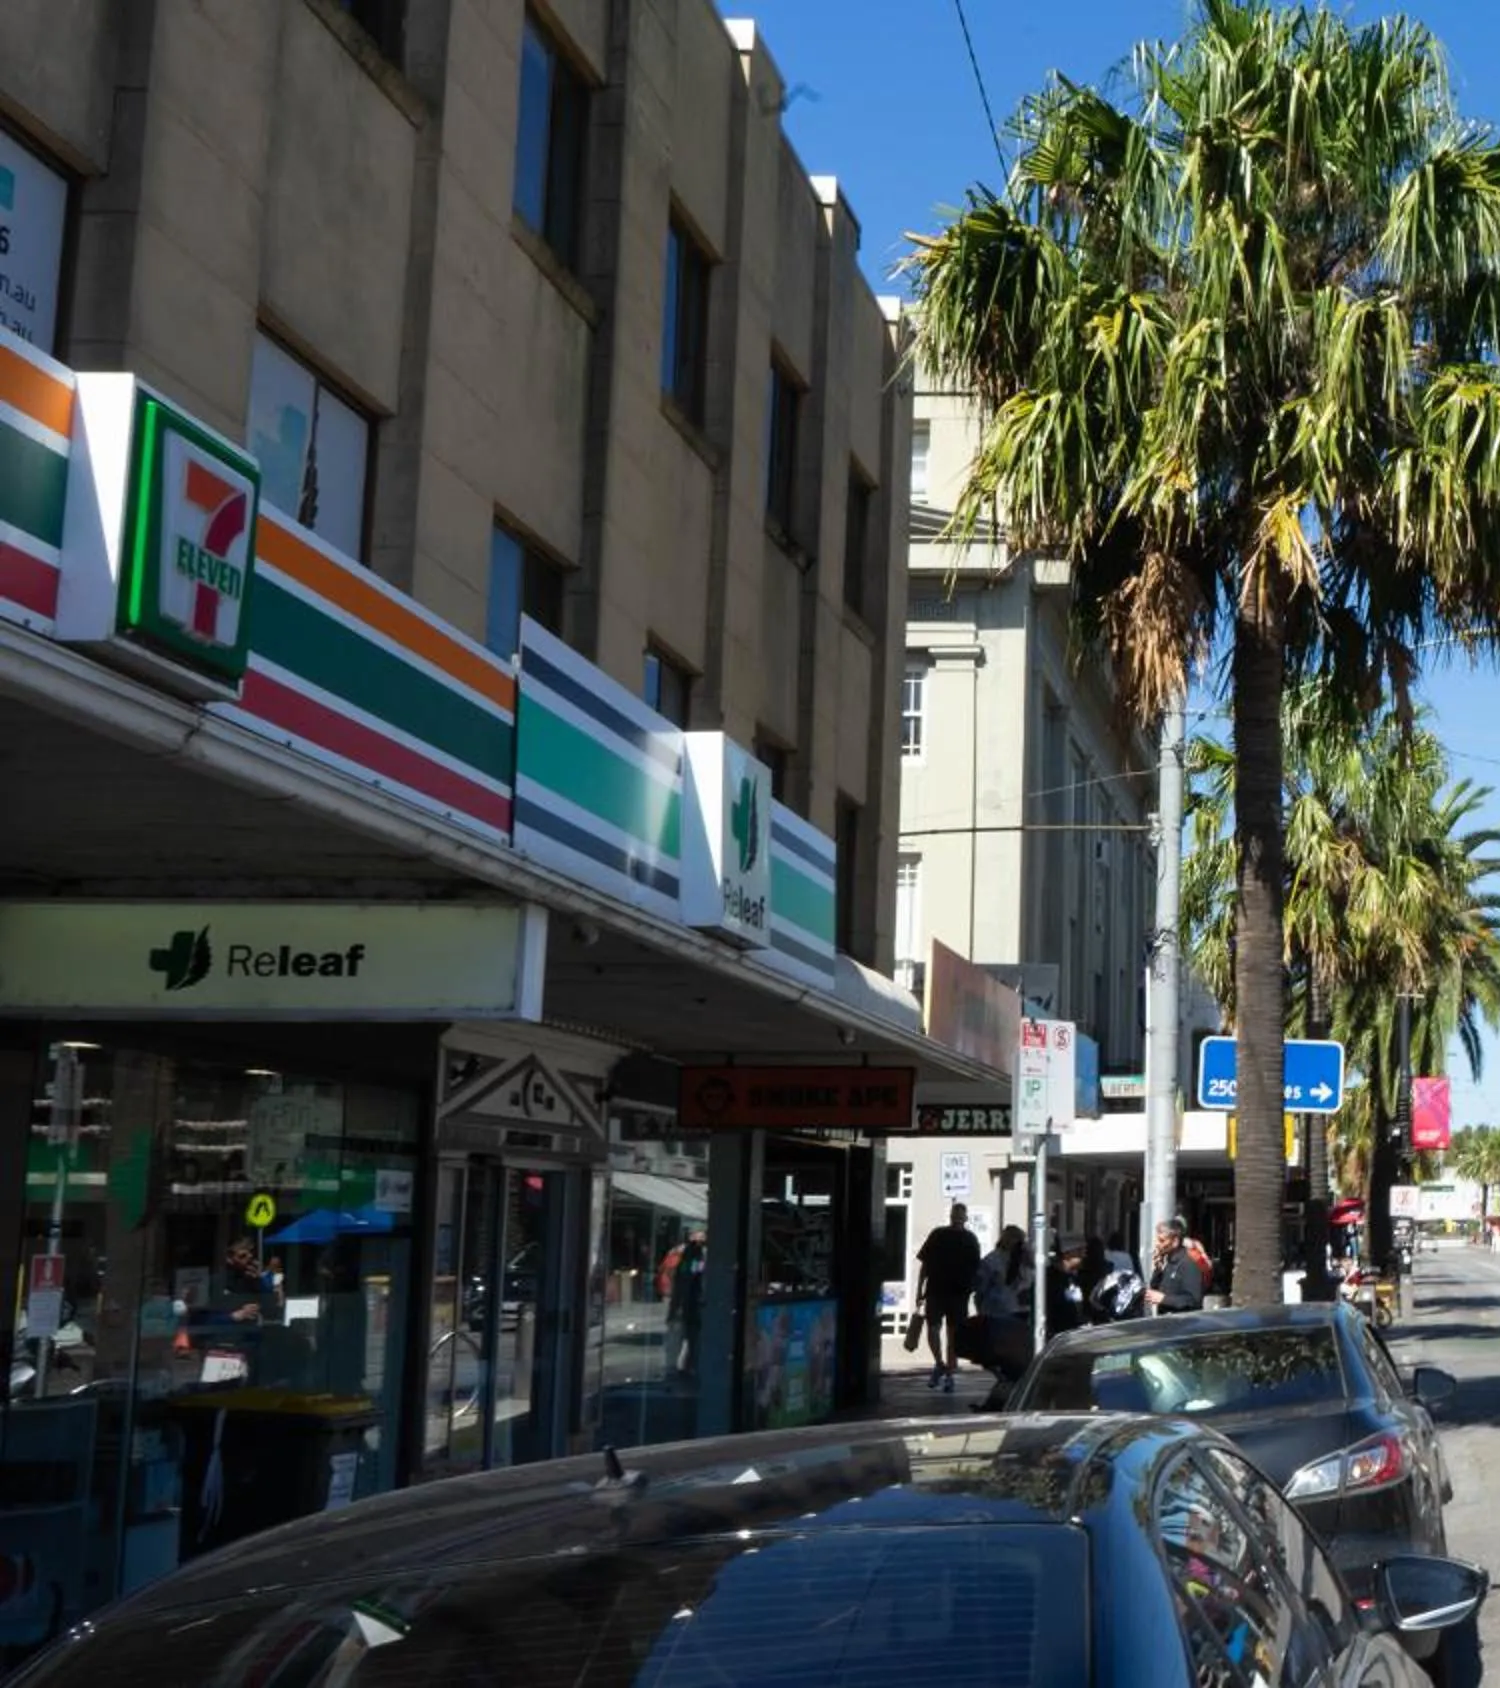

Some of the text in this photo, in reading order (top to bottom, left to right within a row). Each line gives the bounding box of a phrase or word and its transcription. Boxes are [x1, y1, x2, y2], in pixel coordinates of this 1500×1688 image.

[724, 876, 765, 930] Releaf
[227, 943, 365, 978] Releaf
[945, 1156, 967, 1168] ONE
[945, 1171, 966, 1180] WAY
